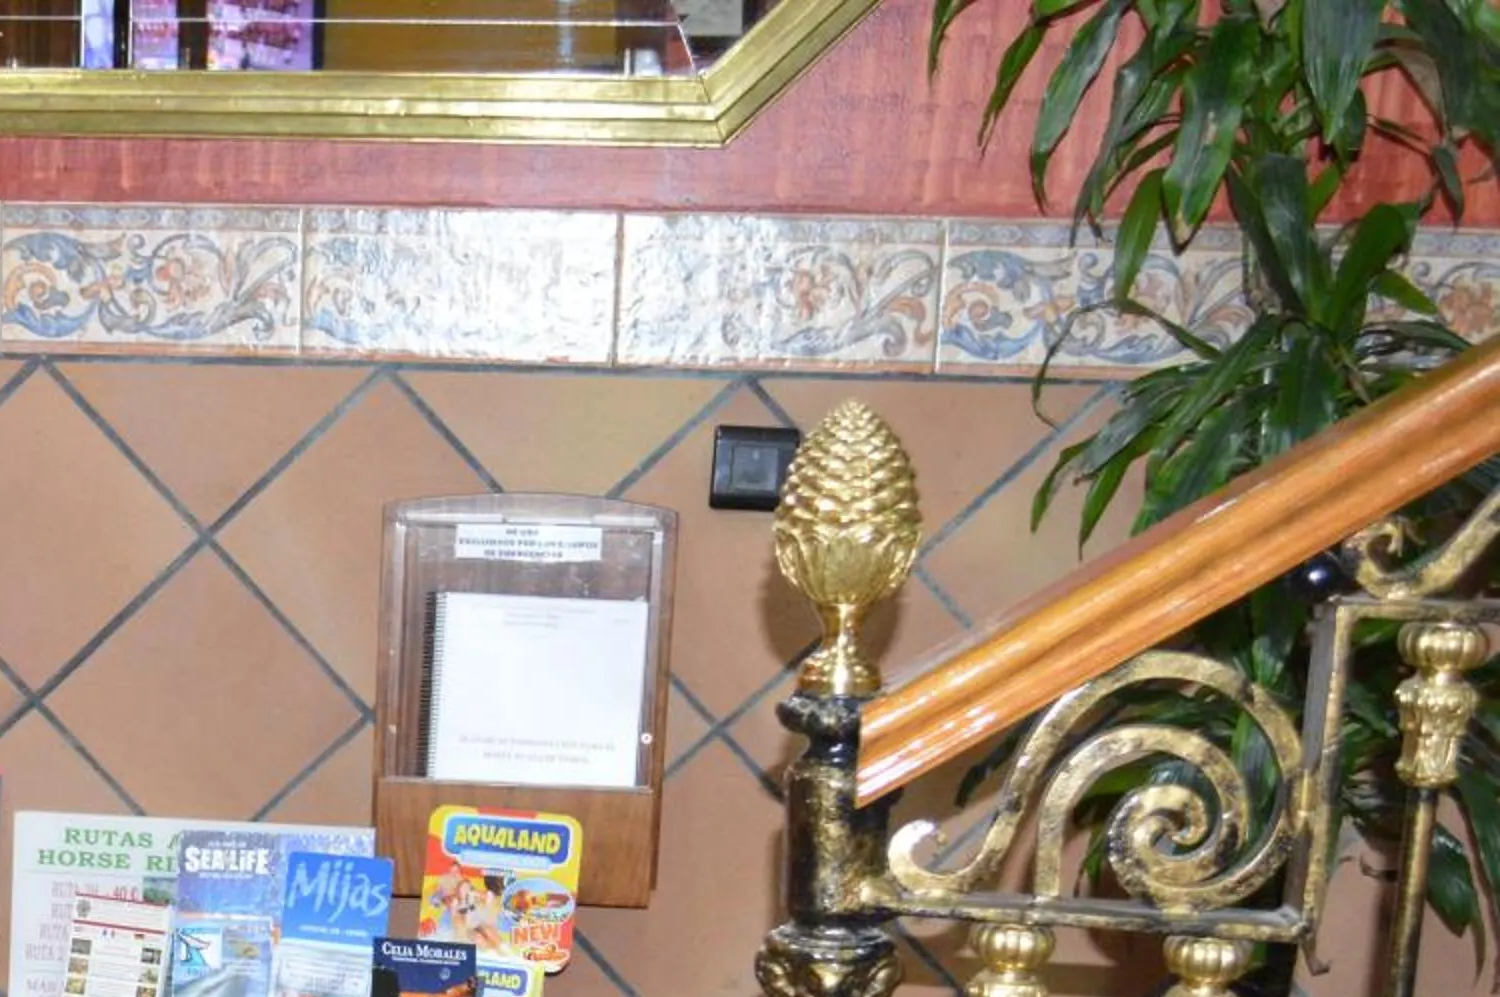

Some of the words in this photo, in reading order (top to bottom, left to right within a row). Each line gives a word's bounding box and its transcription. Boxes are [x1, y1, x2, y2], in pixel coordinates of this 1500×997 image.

[64, 827, 153, 849] RUTAS
[454, 823, 561, 855] AQUALAND
[37, 849, 131, 870] HORSE
[146, 855, 177, 872] RI
[185, 845, 235, 873] SEA
[286, 858, 389, 923] Mijas
[381, 941, 413, 957] CELIA
[416, 944, 467, 961] MORALES
